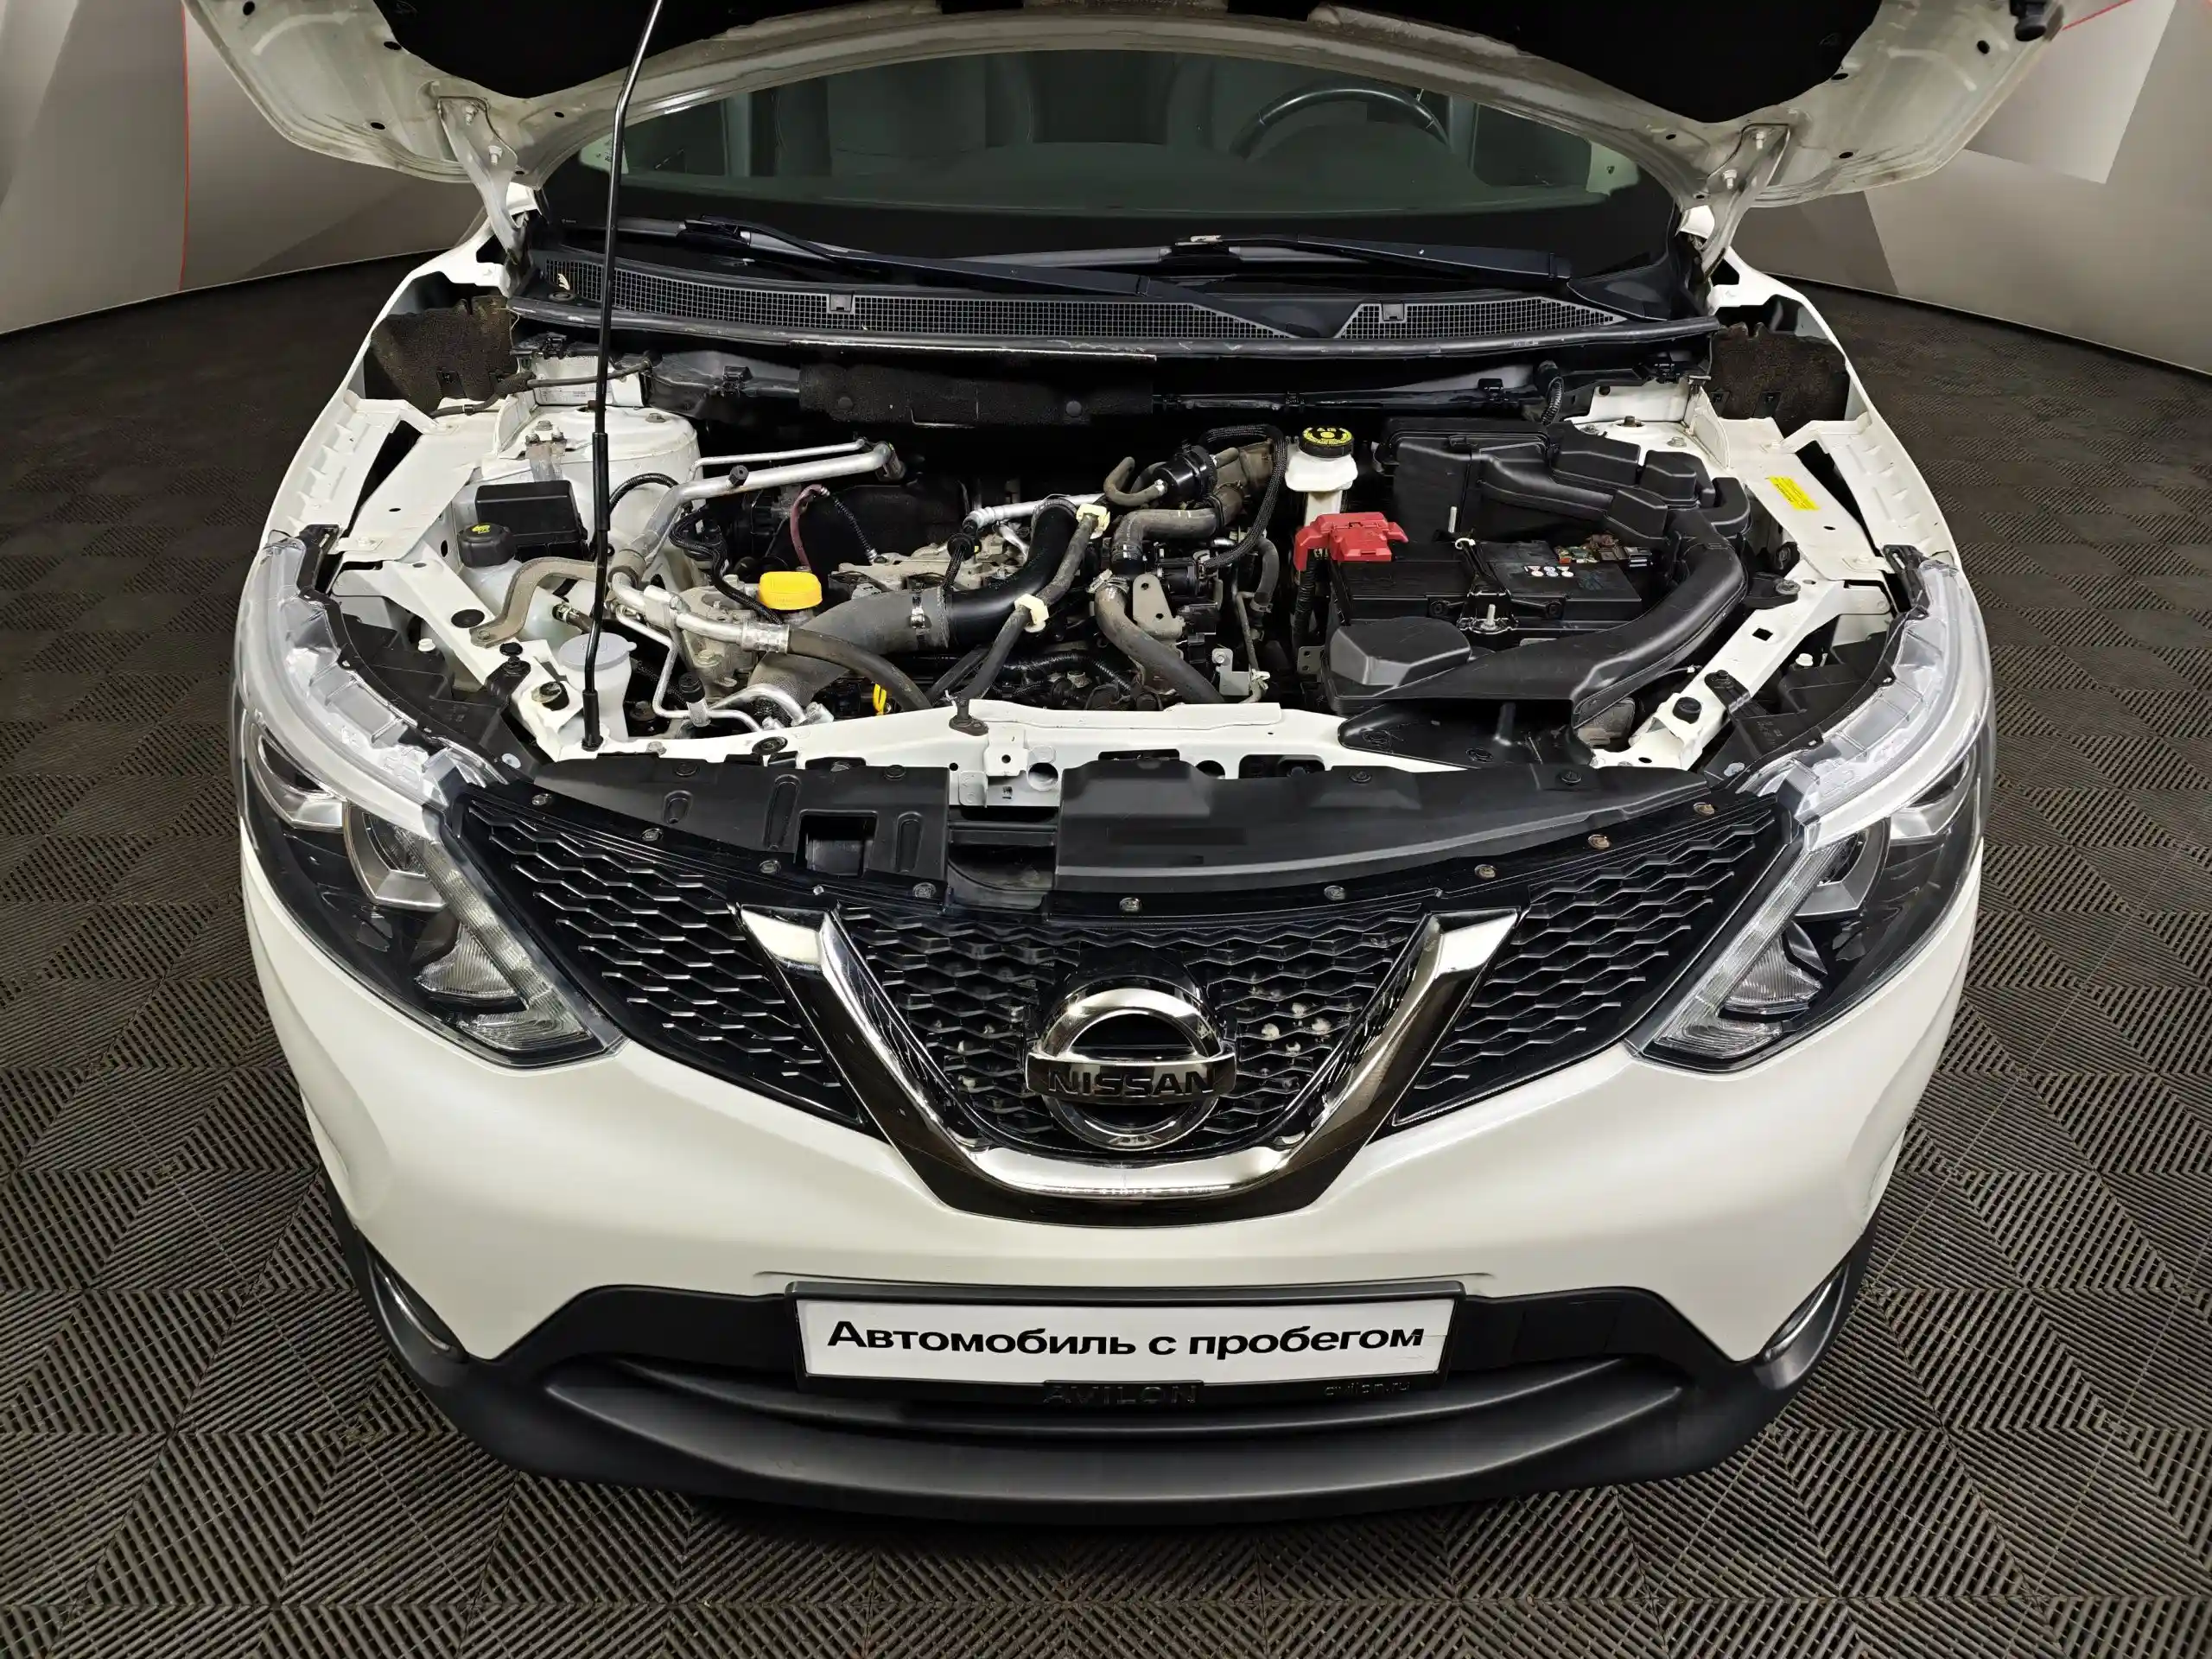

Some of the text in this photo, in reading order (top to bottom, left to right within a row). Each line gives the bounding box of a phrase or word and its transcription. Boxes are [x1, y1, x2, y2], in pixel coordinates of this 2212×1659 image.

[1047, 1069, 1215, 1097] NISSAN
[827, 1320, 1425, 1361] Автомобиль с пробегом
[1043, 1385, 1198, 1404] AVILON
